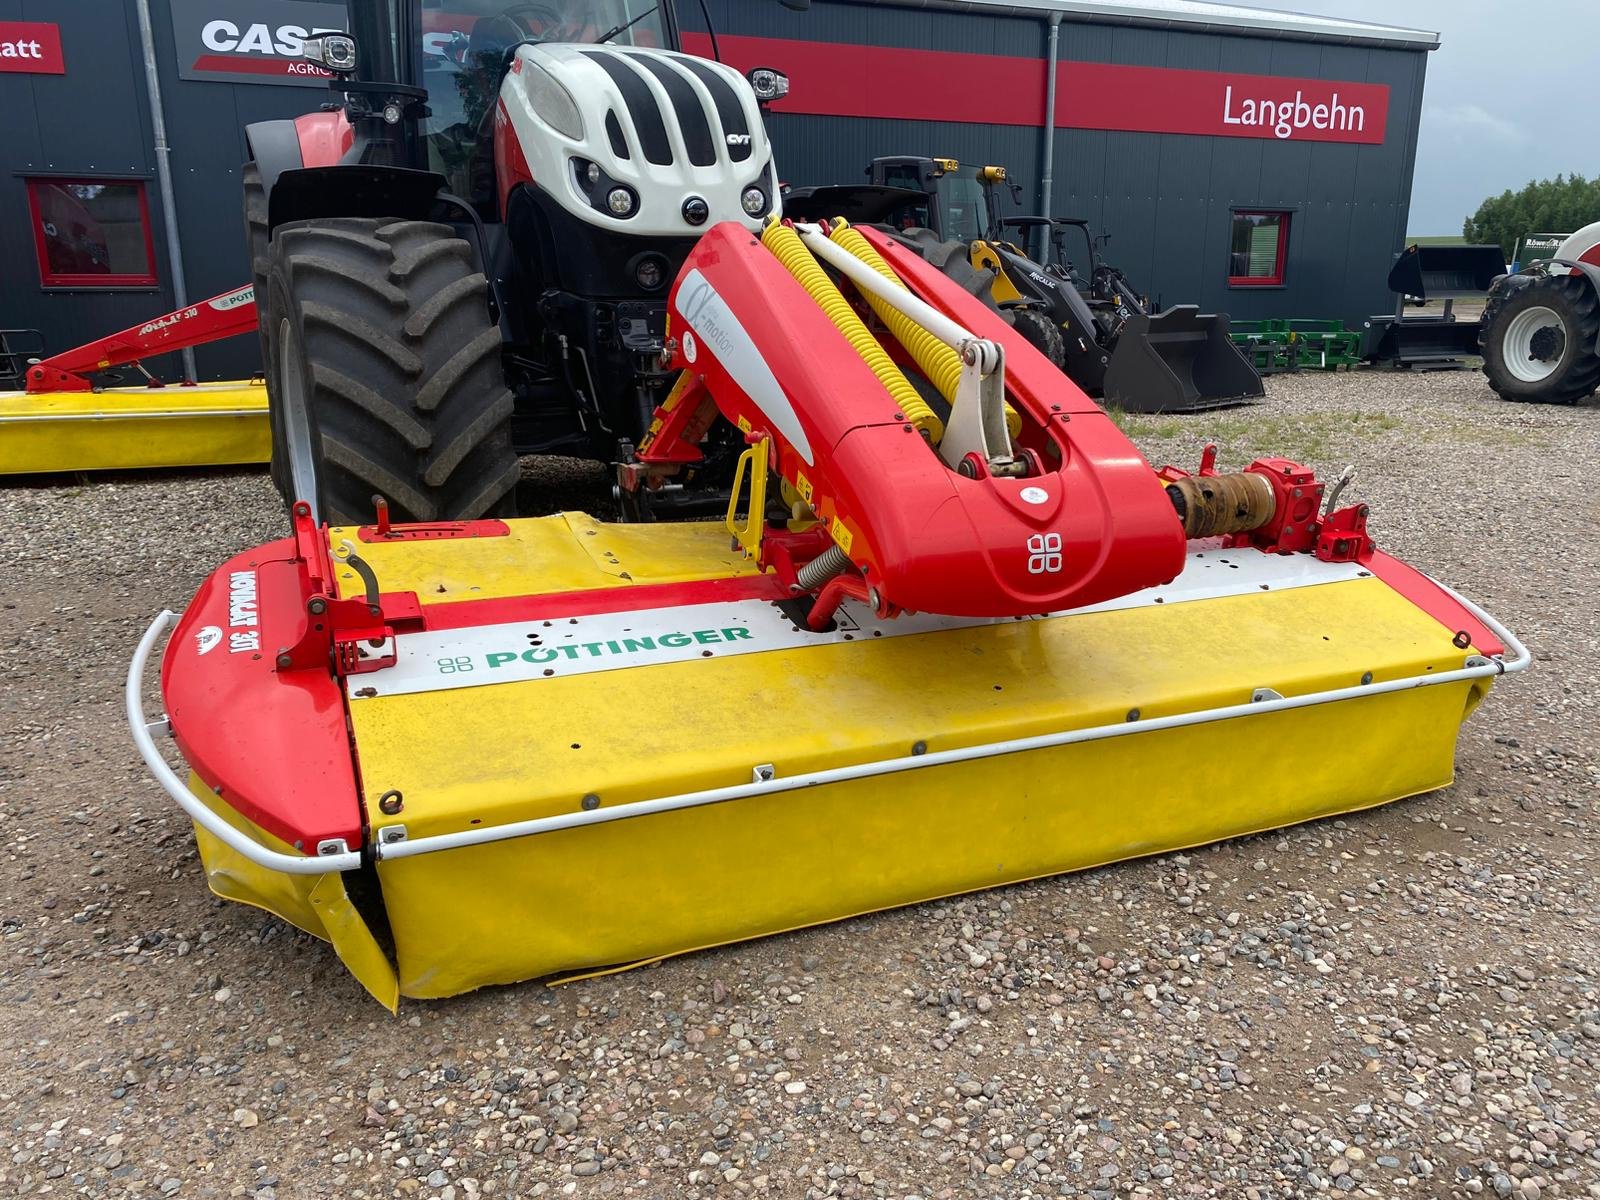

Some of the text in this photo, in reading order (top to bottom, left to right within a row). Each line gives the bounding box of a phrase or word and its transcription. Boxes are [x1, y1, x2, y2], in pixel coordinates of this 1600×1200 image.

[0, 39, 42, 59] att
[201, 19, 343, 56] CAS
[287, 63, 333, 77] AGRIC
[1223, 85, 1365, 139] Langbehn
[726, 133, 751, 146] CVT
[228, 570, 260, 655] NOVACAT 301
[485, 626, 755, 669] PÖTTINGER
